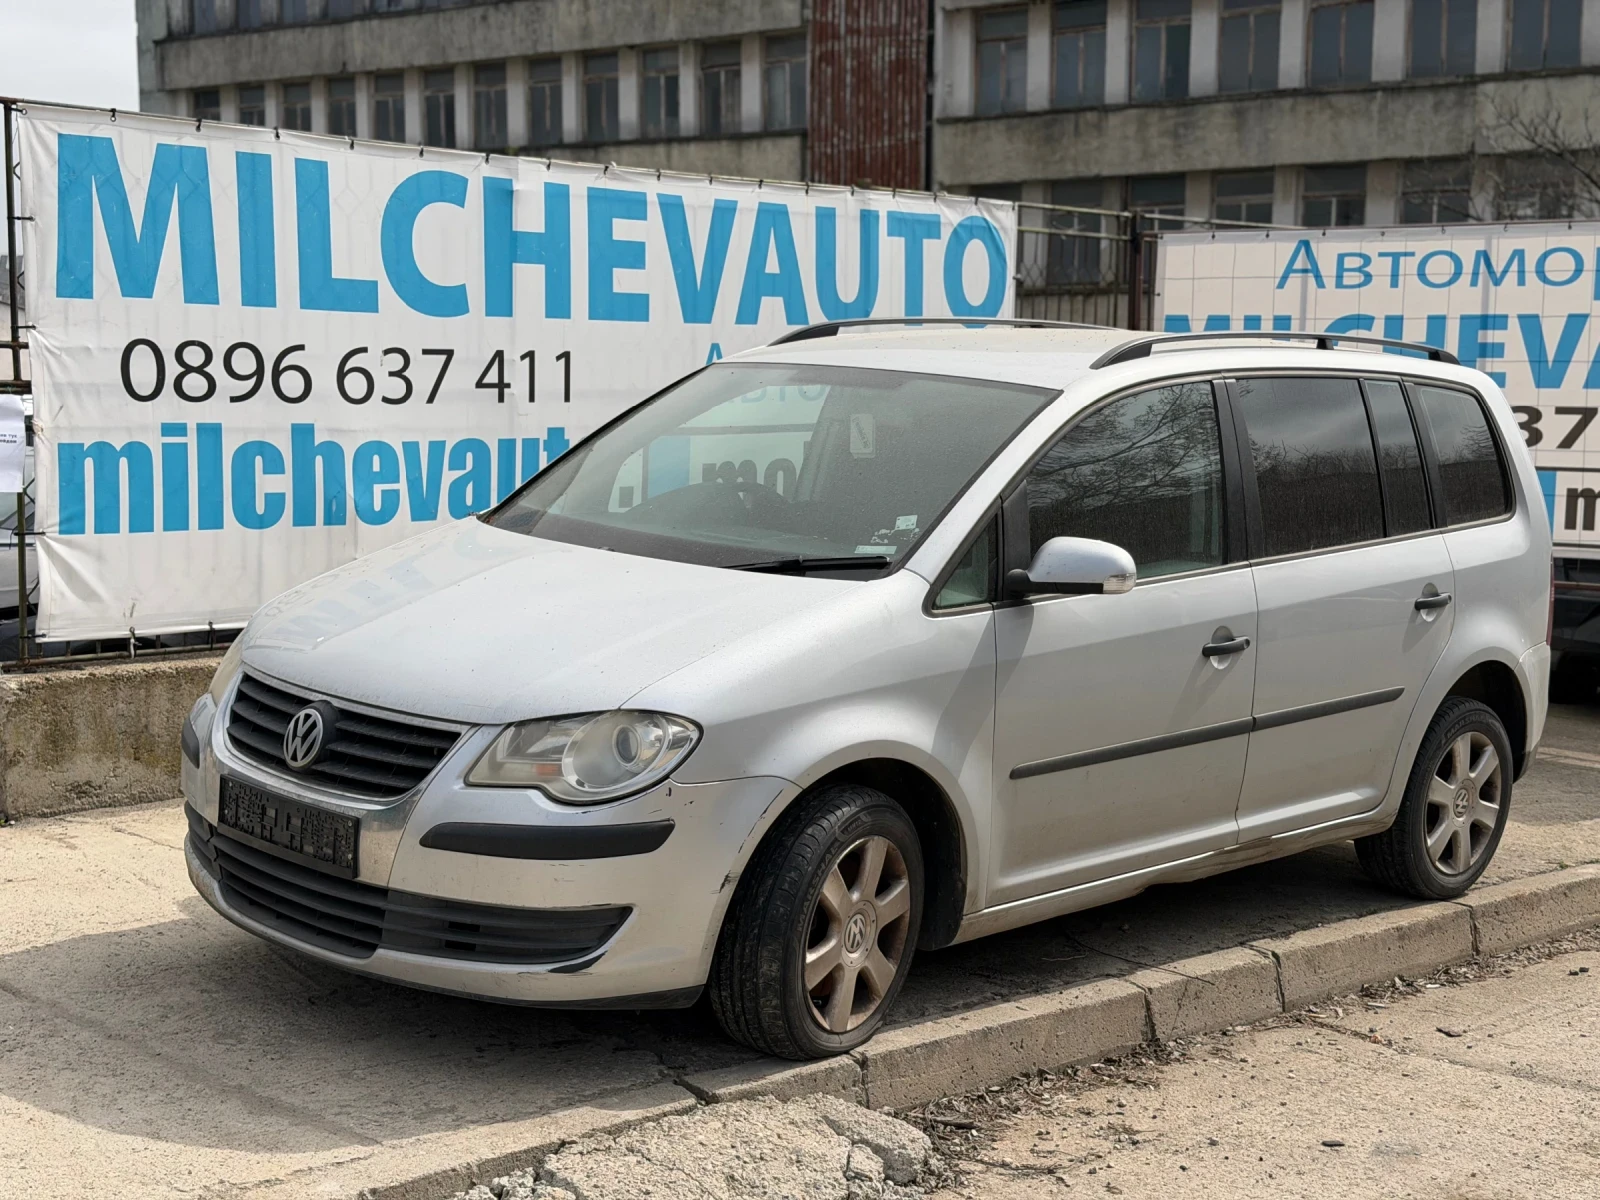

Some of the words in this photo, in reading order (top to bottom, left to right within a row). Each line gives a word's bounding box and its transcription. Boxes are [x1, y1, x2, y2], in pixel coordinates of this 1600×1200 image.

[56, 133, 1008, 328] MILCHEVAUTO
[1276, 239, 1600, 299] Автомо
[120, 338, 312, 402] 0896
[336, 346, 454, 405] 637
[475, 350, 572, 404] 411
